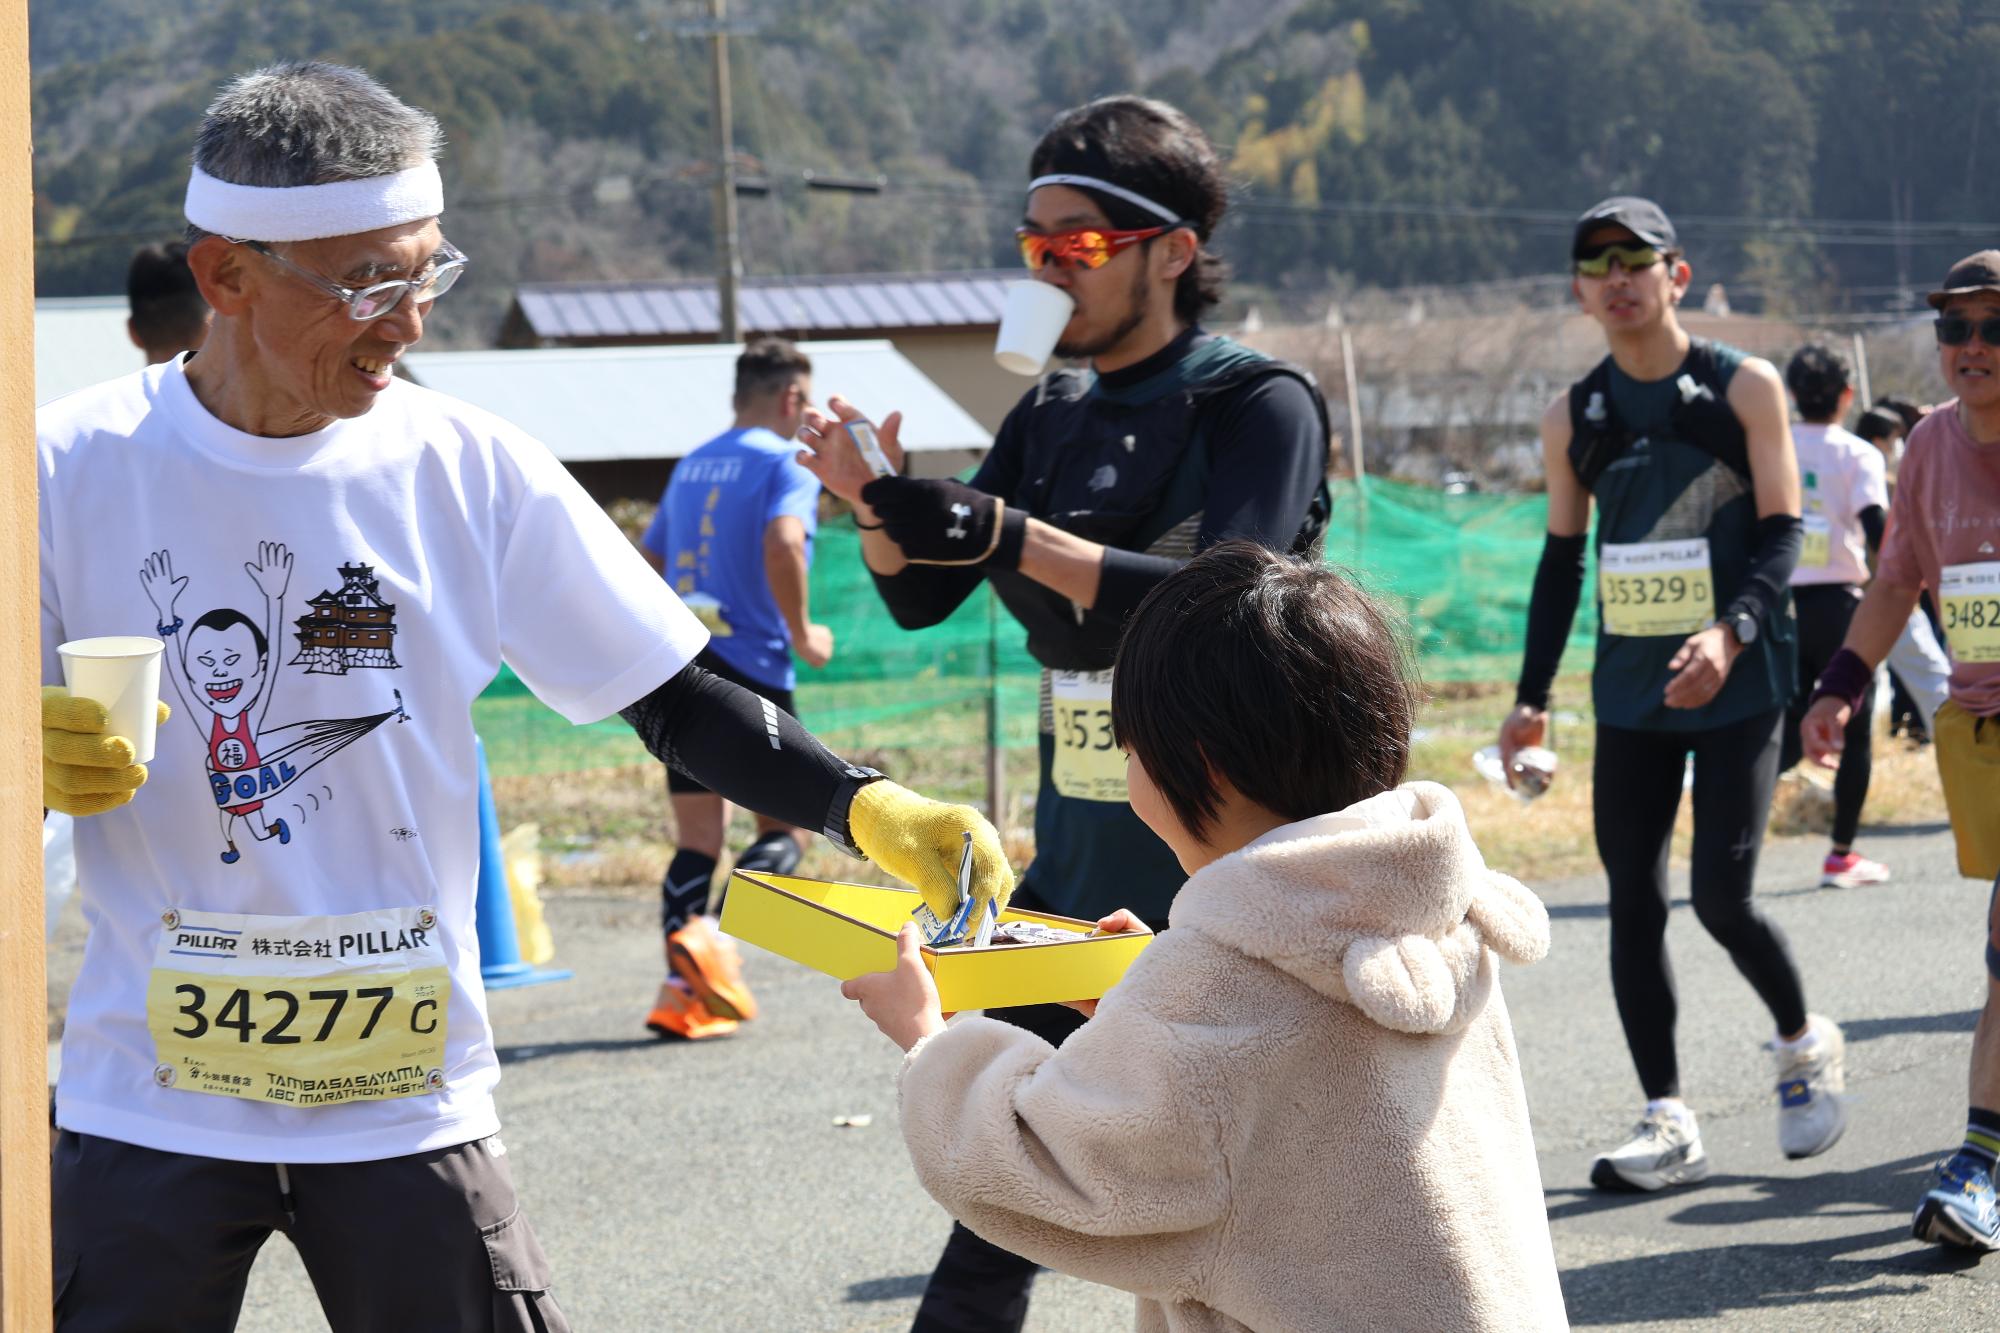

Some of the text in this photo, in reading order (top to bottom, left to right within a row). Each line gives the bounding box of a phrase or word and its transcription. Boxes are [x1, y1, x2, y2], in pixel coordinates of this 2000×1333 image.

[221, 743, 243, 766] 福
[209, 760, 297, 805] GOAL
[176, 933, 237, 950] PILLAR
[252, 927, 430, 958] 株式会社 PILLAR
[173, 983, 394, 1045] 34277
[410, 999, 437, 1034] C
[266, 1065, 424, 1091] TAMBASASAYAMA
[265, 1087, 295, 1102] ABC
[300, 1087, 385, 1104] MARATHON
